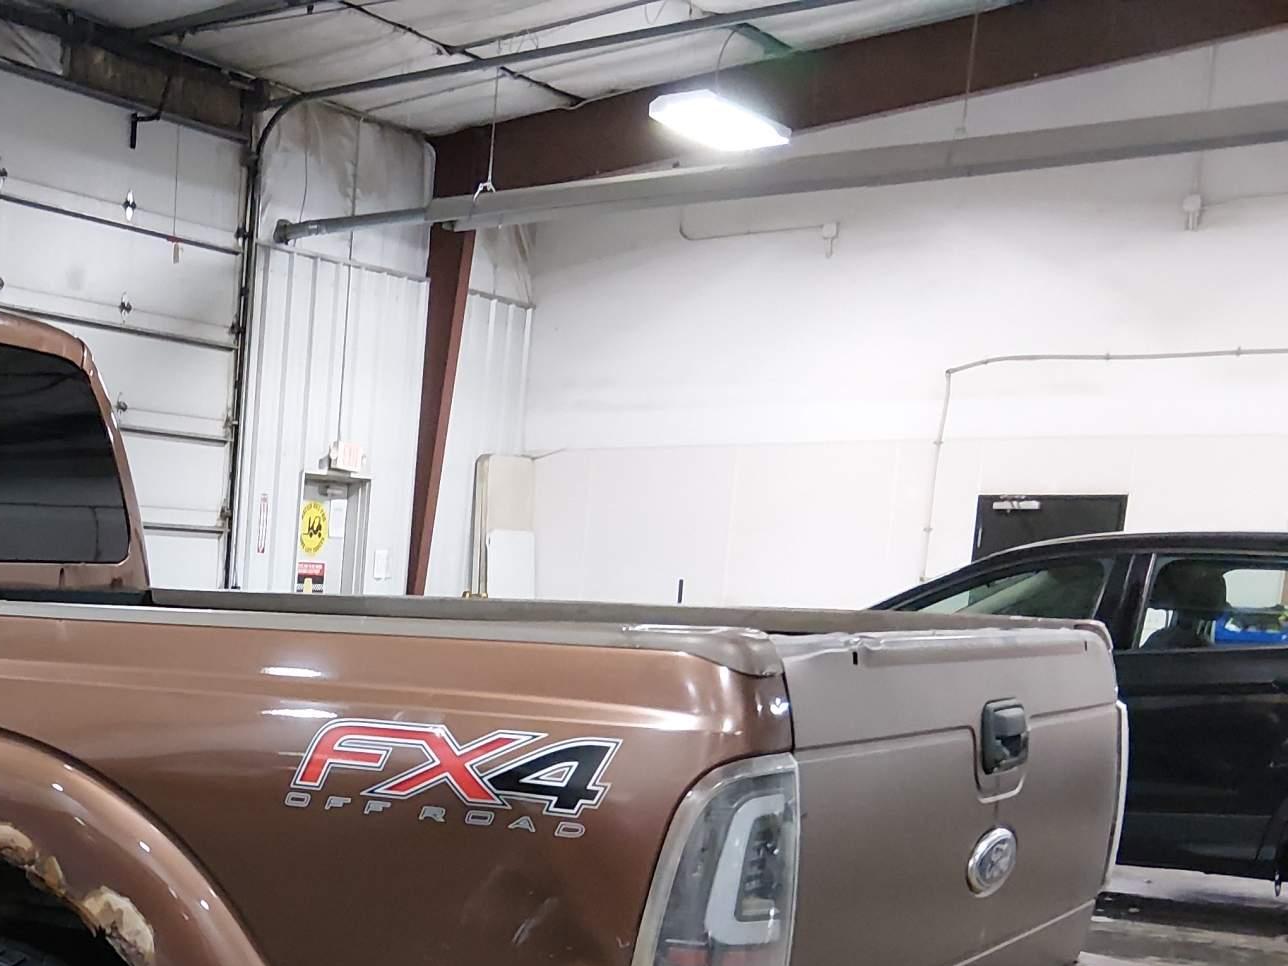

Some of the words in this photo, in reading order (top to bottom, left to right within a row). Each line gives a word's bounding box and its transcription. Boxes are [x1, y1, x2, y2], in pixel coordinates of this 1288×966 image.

[290, 718, 623, 818] FX4
[285, 791, 392, 815] OFF
[418, 806, 587, 839] ROAD
